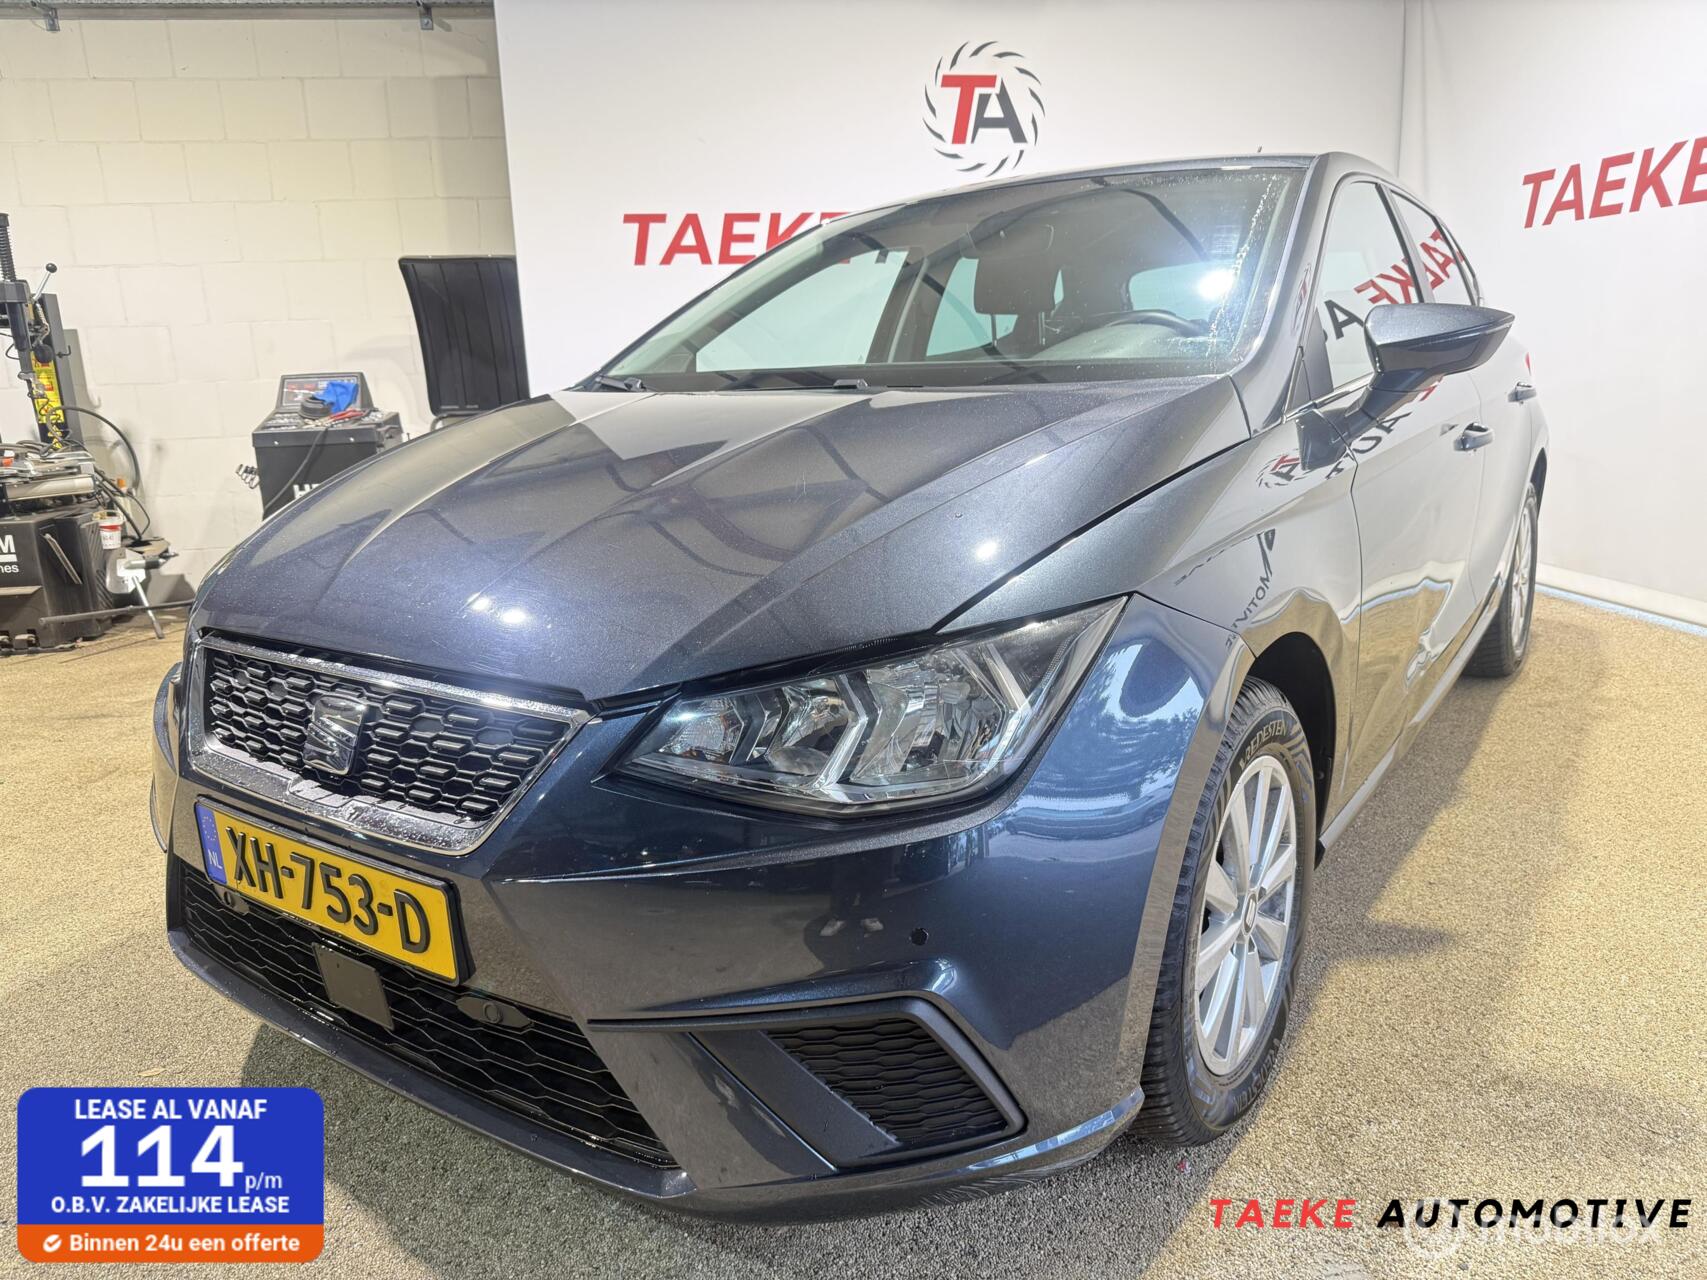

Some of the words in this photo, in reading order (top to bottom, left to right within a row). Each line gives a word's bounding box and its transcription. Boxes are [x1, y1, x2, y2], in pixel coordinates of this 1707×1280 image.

[940, 74, 1028, 144] TA
[207, 848, 223, 870] NL
[224, 826, 430, 954] XH-753-D
